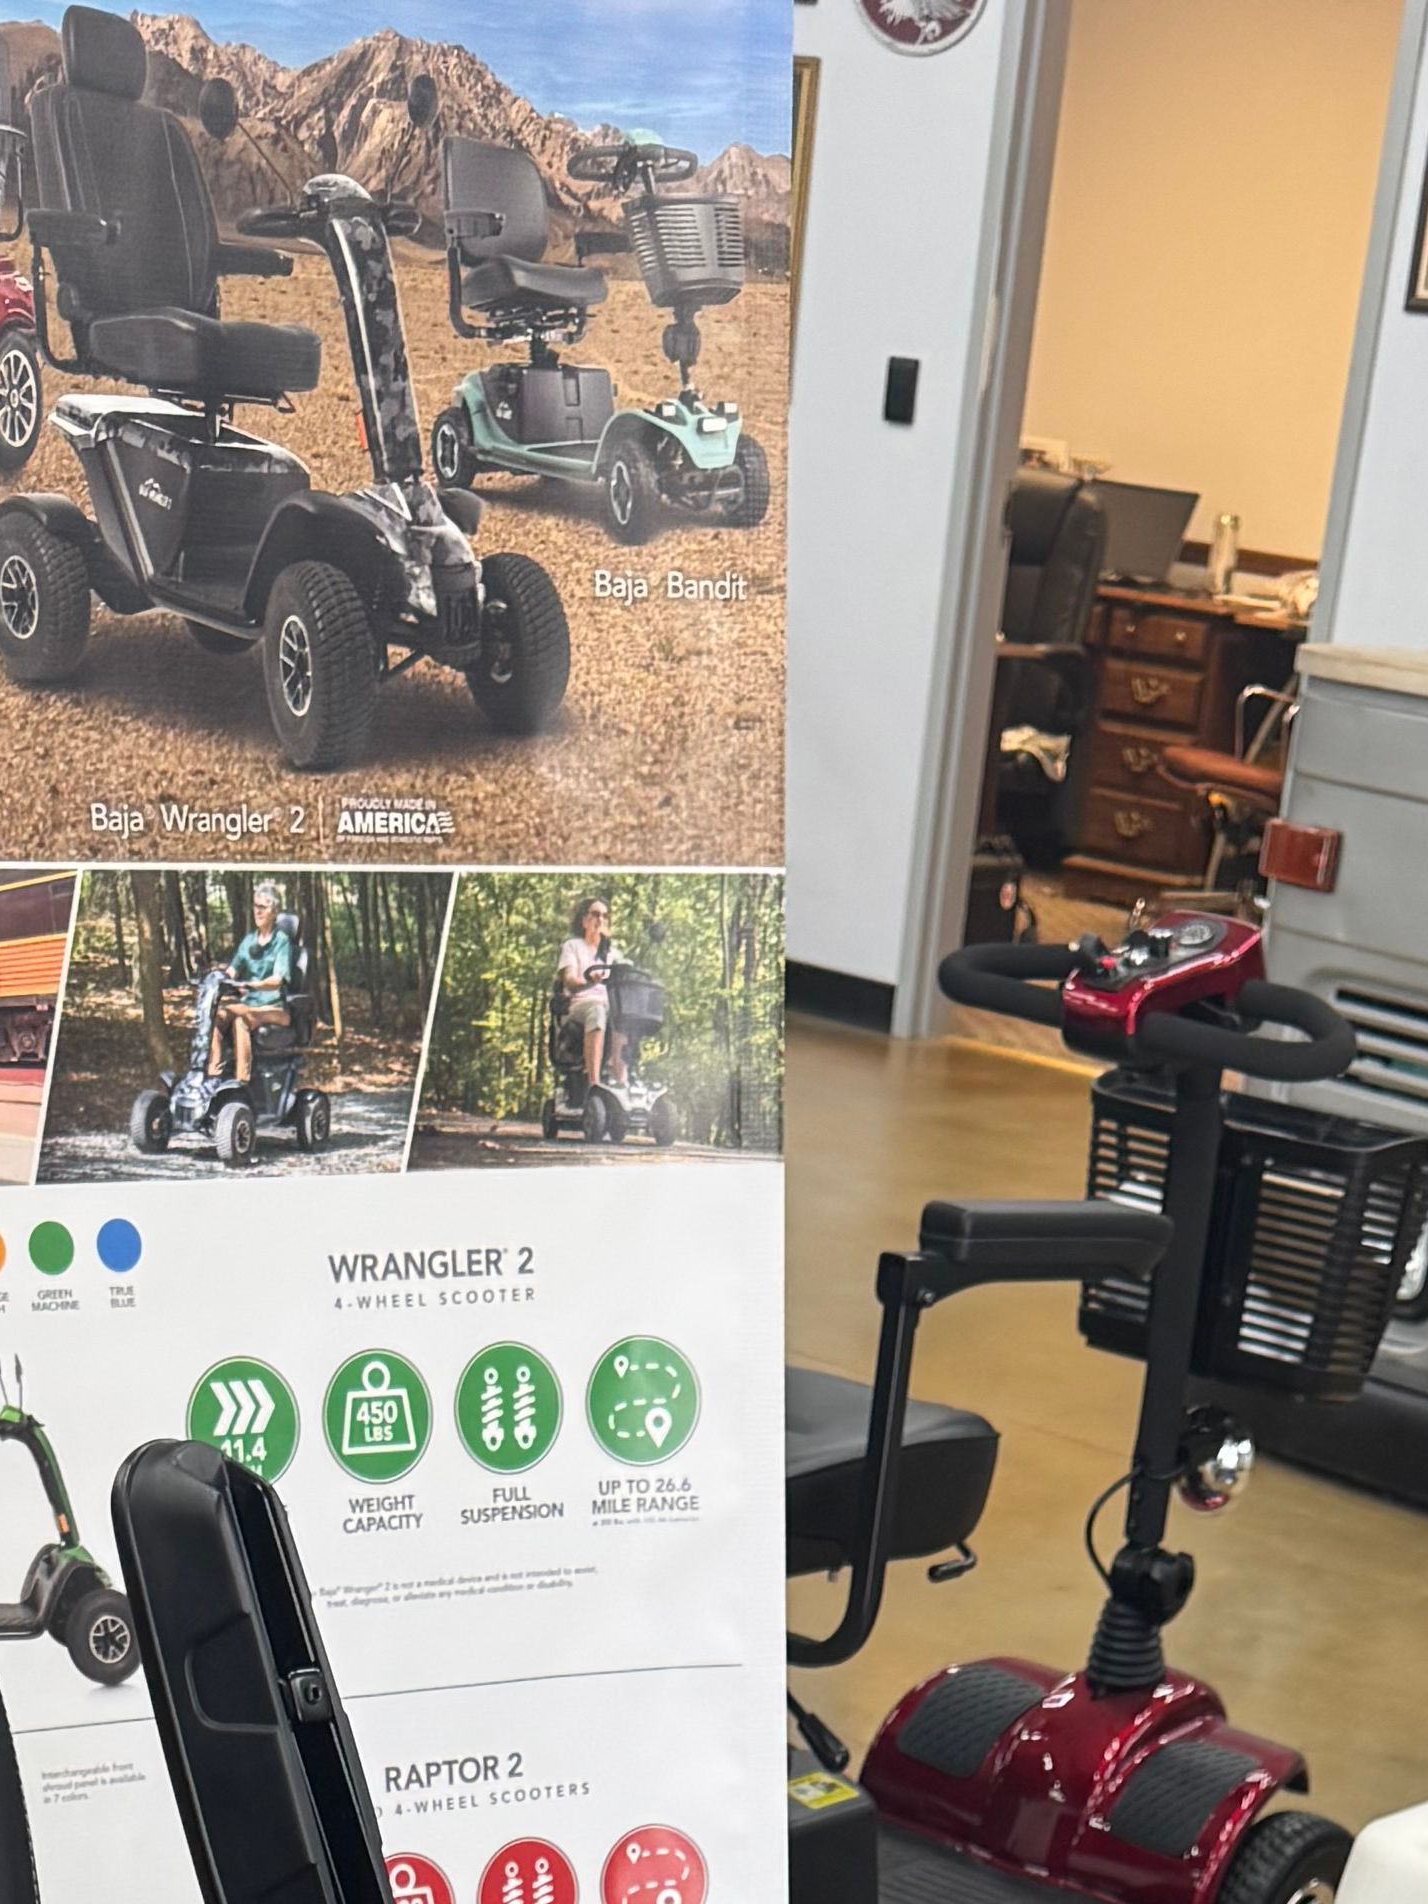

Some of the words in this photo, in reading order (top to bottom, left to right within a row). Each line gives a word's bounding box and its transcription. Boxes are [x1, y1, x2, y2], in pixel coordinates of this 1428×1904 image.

[667, 570, 748, 600] Bandit
[393, 799, 421, 810] MADE
[423, 800, 436, 810] IN
[290, 806, 305, 834] 2
[337, 811, 448, 835] AMERICA
[517, 1246, 535, 1275] 2
[37, 1289, 73, 1300] GREEN
[109, 1285, 134, 1297] TRUE
[334, 1292, 427, 1310] 4-WHEEL
[439, 1287, 535, 1306] SCOOTER
[31, 1299, 80, 1312] MACHINE
[110, 1296, 136, 1309] BLUE
[356, 1400, 398, 1425] 450
[364, 1425, 393, 1442] LBS
[492, 1486, 531, 1503] FULL
[598, 1480, 622, 1496] UP
[626, 1478, 650, 1494] TO
[655, 1476, 692, 1493] 26.6
[348, 1495, 415, 1514] WEIGHT
[460, 1503, 564, 1525] SUSPENSION
[591, 1498, 631, 1515] MILE
[636, 1495, 700, 1513] RANGE
[342, 1512, 423, 1534] CAPACITY
[384, 1755, 500, 1793] RAPTOR
[507, 1752, 523, 1778] 2
[394, 1793, 479, 1816] 4-WHEEL
[489, 1782, 590, 1805] SCOOTERS
